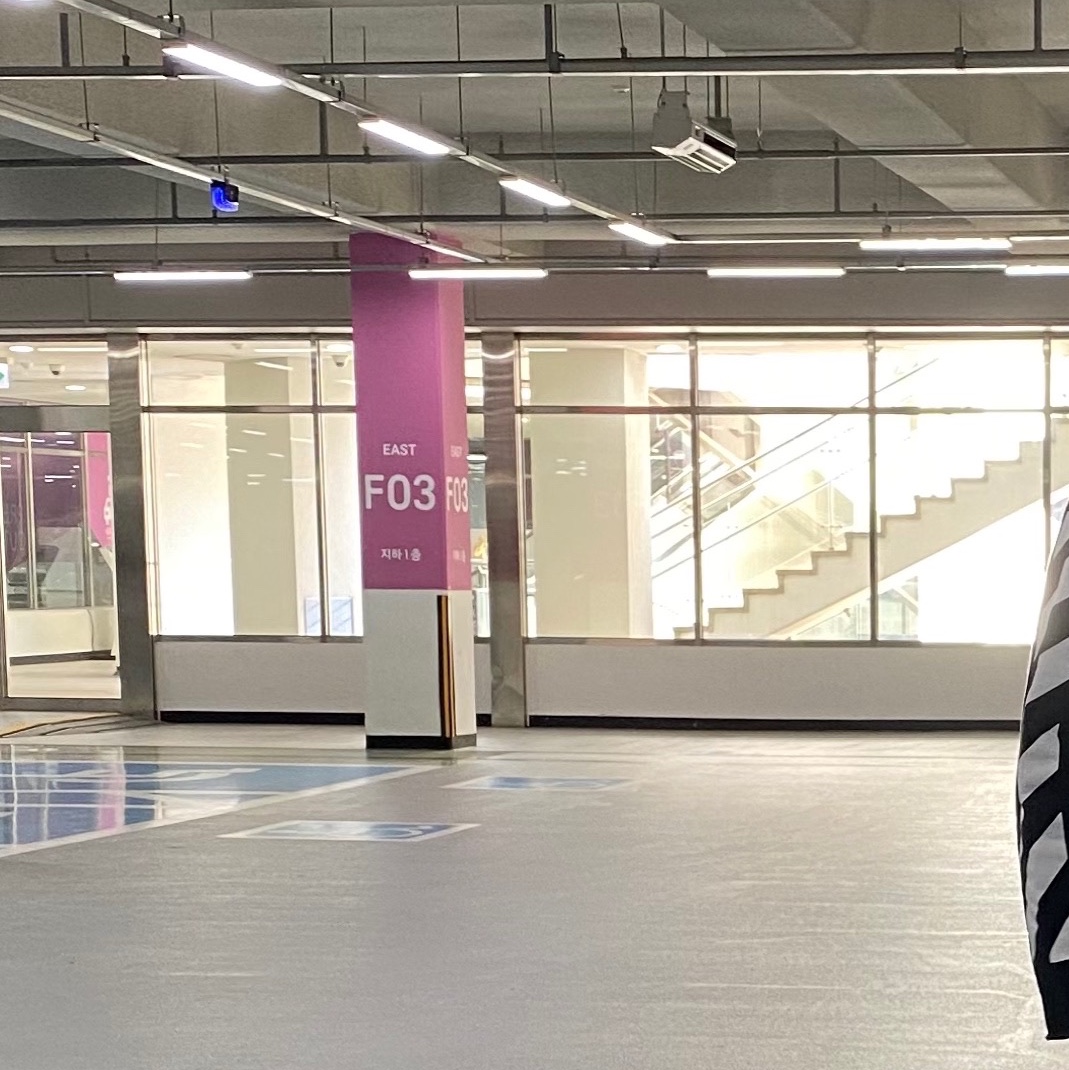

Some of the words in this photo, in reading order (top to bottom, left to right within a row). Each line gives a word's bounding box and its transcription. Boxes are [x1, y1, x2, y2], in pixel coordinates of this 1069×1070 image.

[382, 443, 417, 456] EAST
[364, 473, 436, 511] F03
[445, 475, 469, 513] F03
